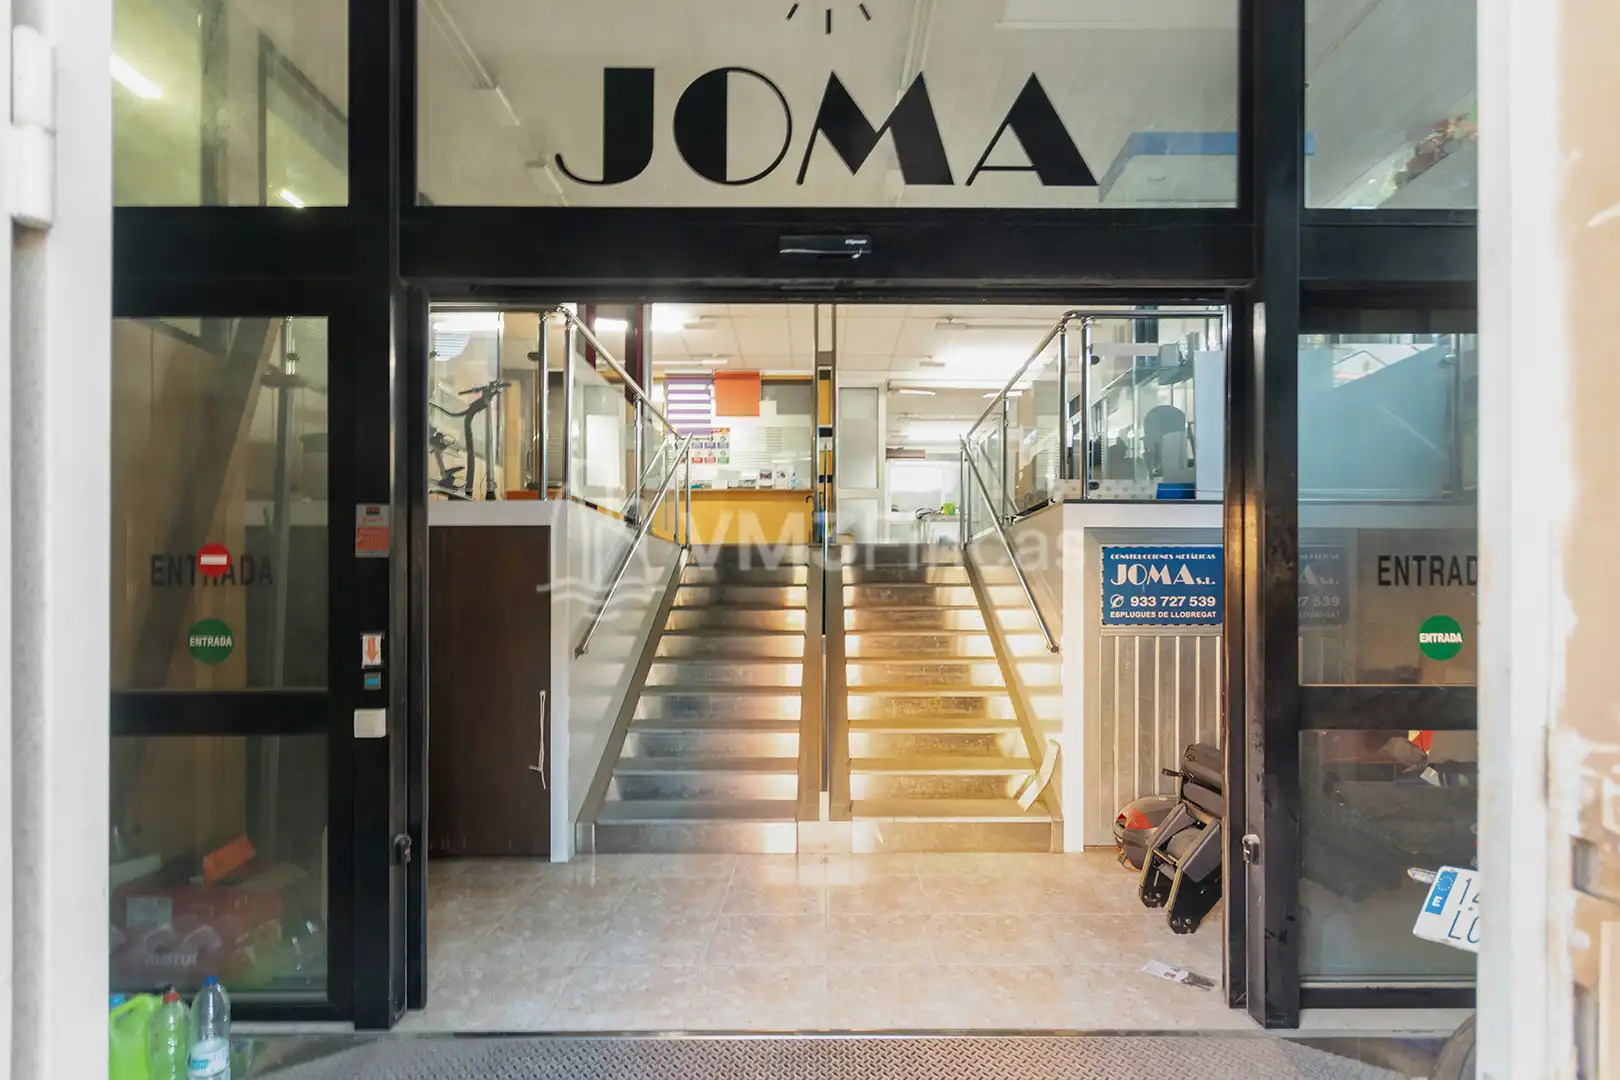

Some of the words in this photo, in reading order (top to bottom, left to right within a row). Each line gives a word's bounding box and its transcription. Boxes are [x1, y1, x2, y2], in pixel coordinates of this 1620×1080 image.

[555, 66, 1099, 186] JOMA
[151, 554, 273, 587] ENTADA
[1110, 563, 1195, 586] JOMA
[1130, 596, 1157, 607] 933
[1160, 596, 1187, 607] 727
[1189, 596, 1216, 607] 539
[189, 635, 233, 648] ENTRADA
[1419, 632, 1463, 643] ENTRADA
[1431, 895, 1443, 907] E
